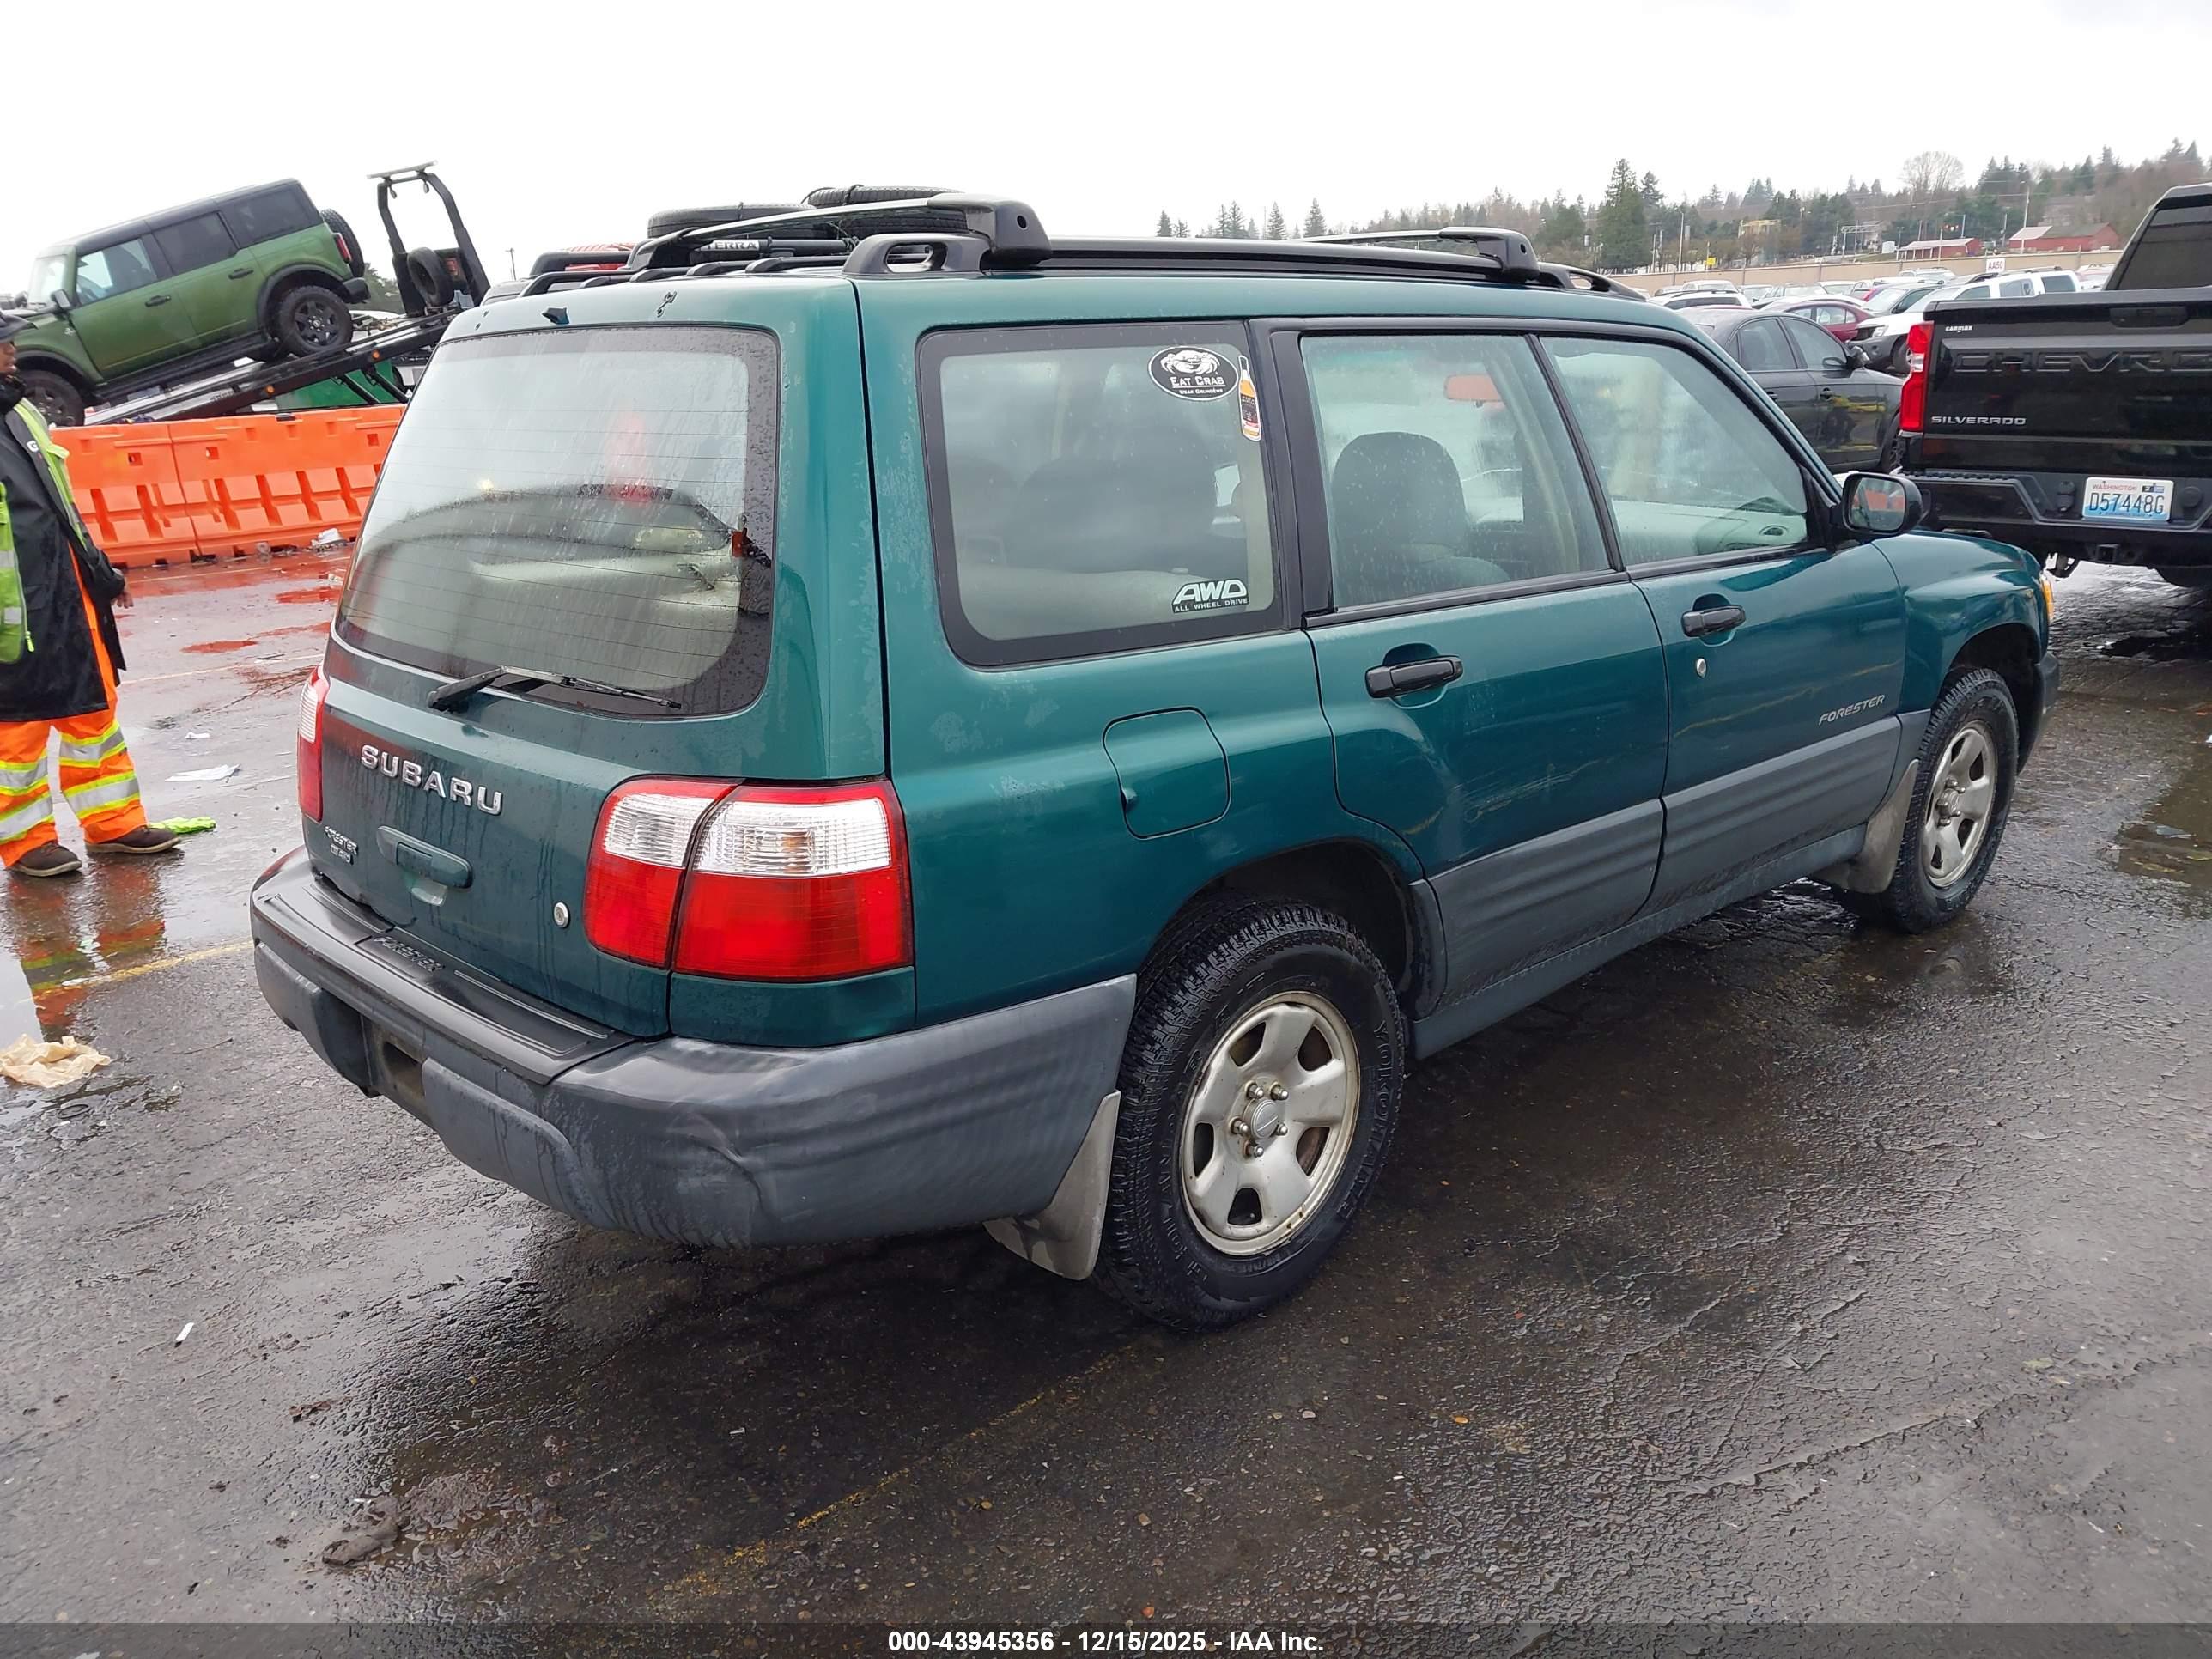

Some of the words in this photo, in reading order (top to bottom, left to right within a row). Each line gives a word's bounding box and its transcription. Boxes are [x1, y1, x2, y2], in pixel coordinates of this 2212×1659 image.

[1988, 261, 2003, 270] AA50
[1930, 416, 2027, 425] SILVERADO
[2093, 483, 2137, 493] WASHINGTON
[2088, 492, 2165, 515] D57448G
[1173, 579, 1248, 605] AWD
[1194, 601, 1222, 611] WHEEL
[1224, 598, 1248, 606] DRIVE
[1818, 694, 1886, 726] FORESTER
[361, 744, 502, 816] SUBARU
